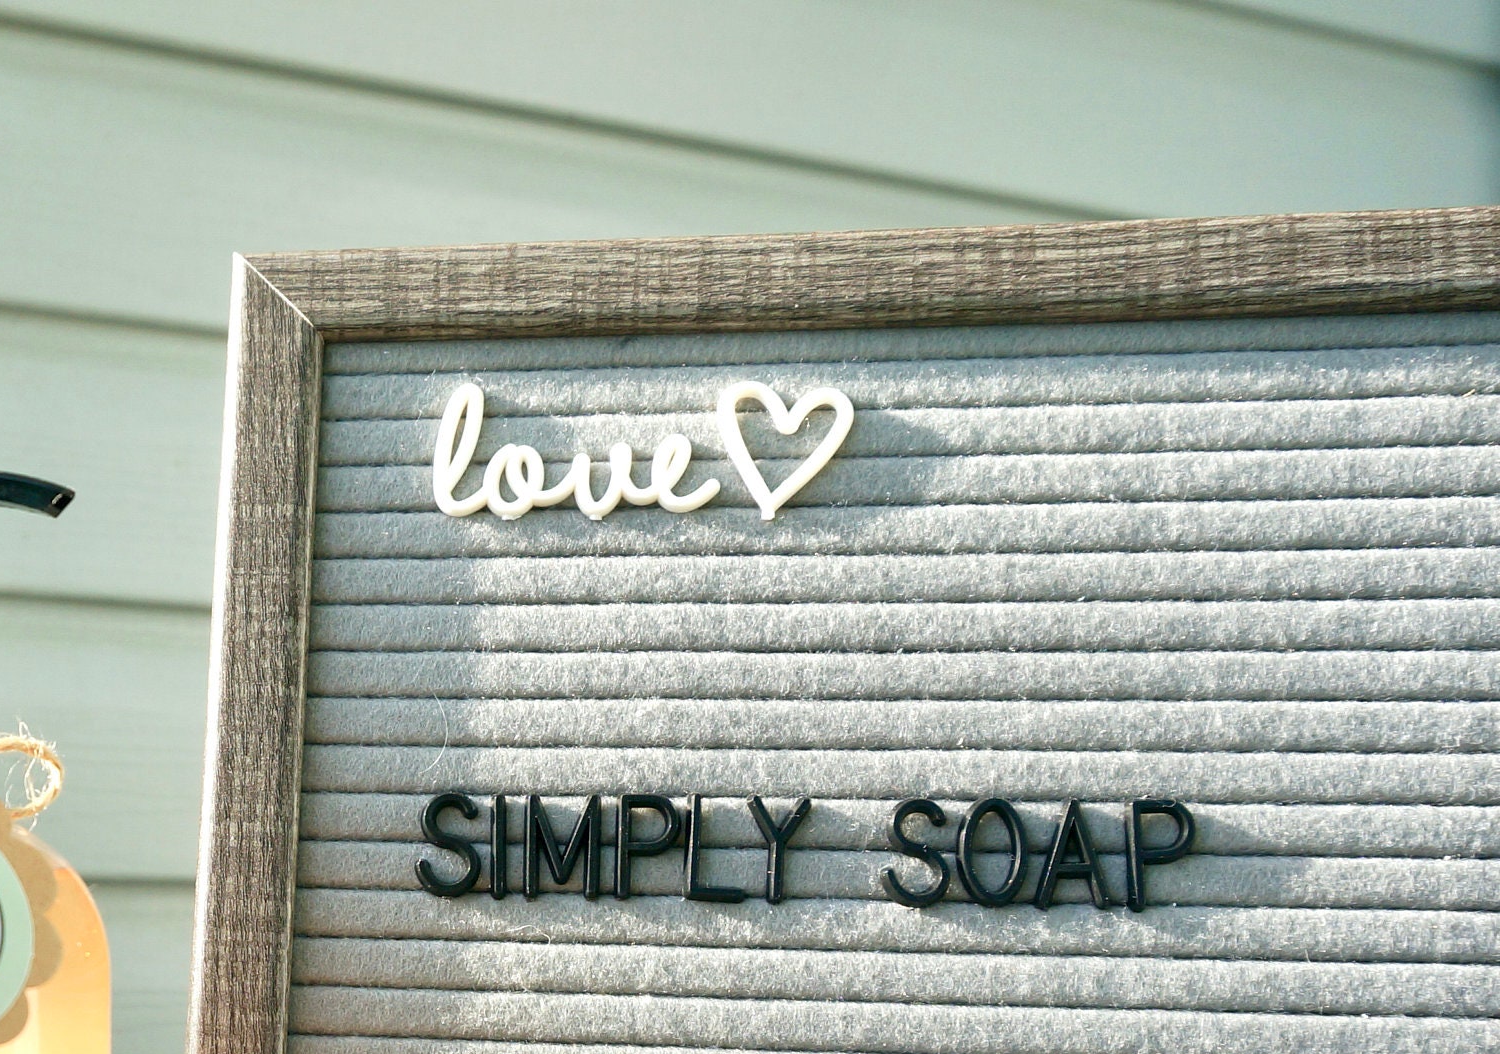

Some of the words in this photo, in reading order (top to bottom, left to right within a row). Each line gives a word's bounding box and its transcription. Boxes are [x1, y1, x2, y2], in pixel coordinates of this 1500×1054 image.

[433, 383, 720, 520] love
[414, 793, 812, 905] SIMPLY
[881, 799, 1197, 913] SOAP
